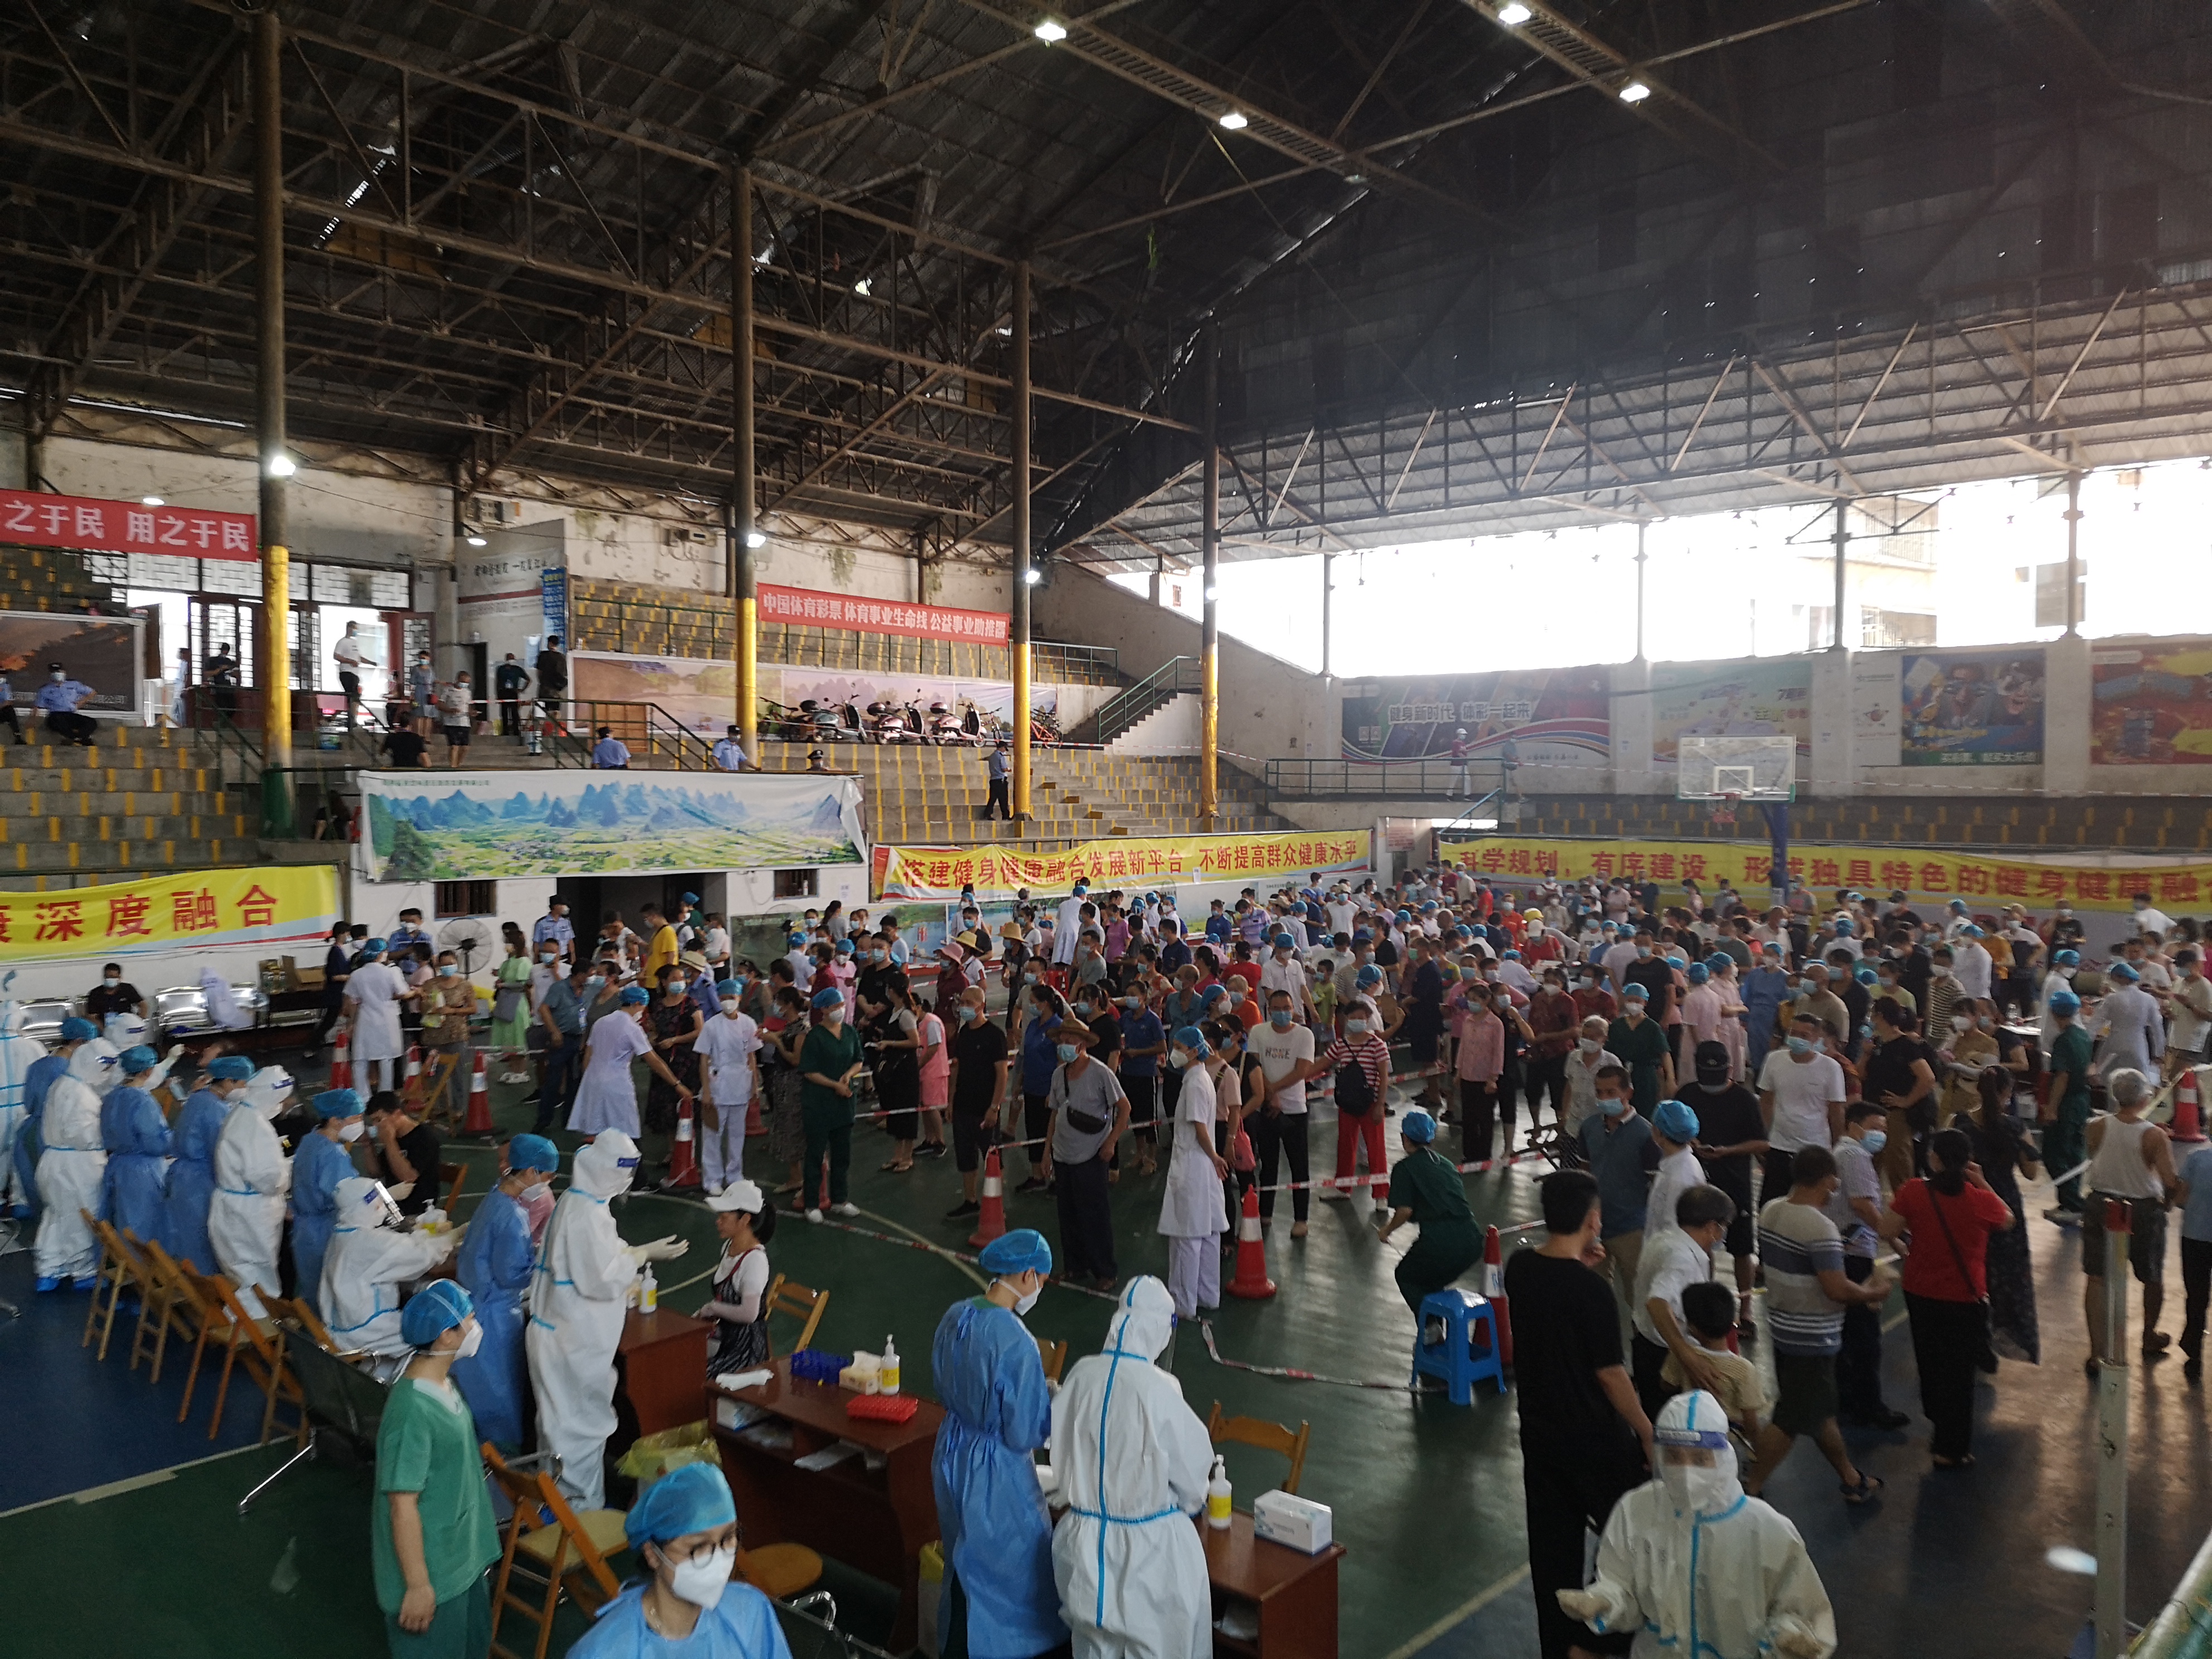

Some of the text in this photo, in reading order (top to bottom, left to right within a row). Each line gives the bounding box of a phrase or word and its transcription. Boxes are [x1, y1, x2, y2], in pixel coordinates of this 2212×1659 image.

[4, 500, 249, 552] 之于民 用之于民
[763, 592, 1006, 639] 中国体育彩票 体育事业生命线 公益事业助推器
[1389, 701, 1531, 724] 健身新时代 体彩一起来
[903, 840, 1357, 889] 搭建健身健康融合发展新平台 不断提高群众健康水平
